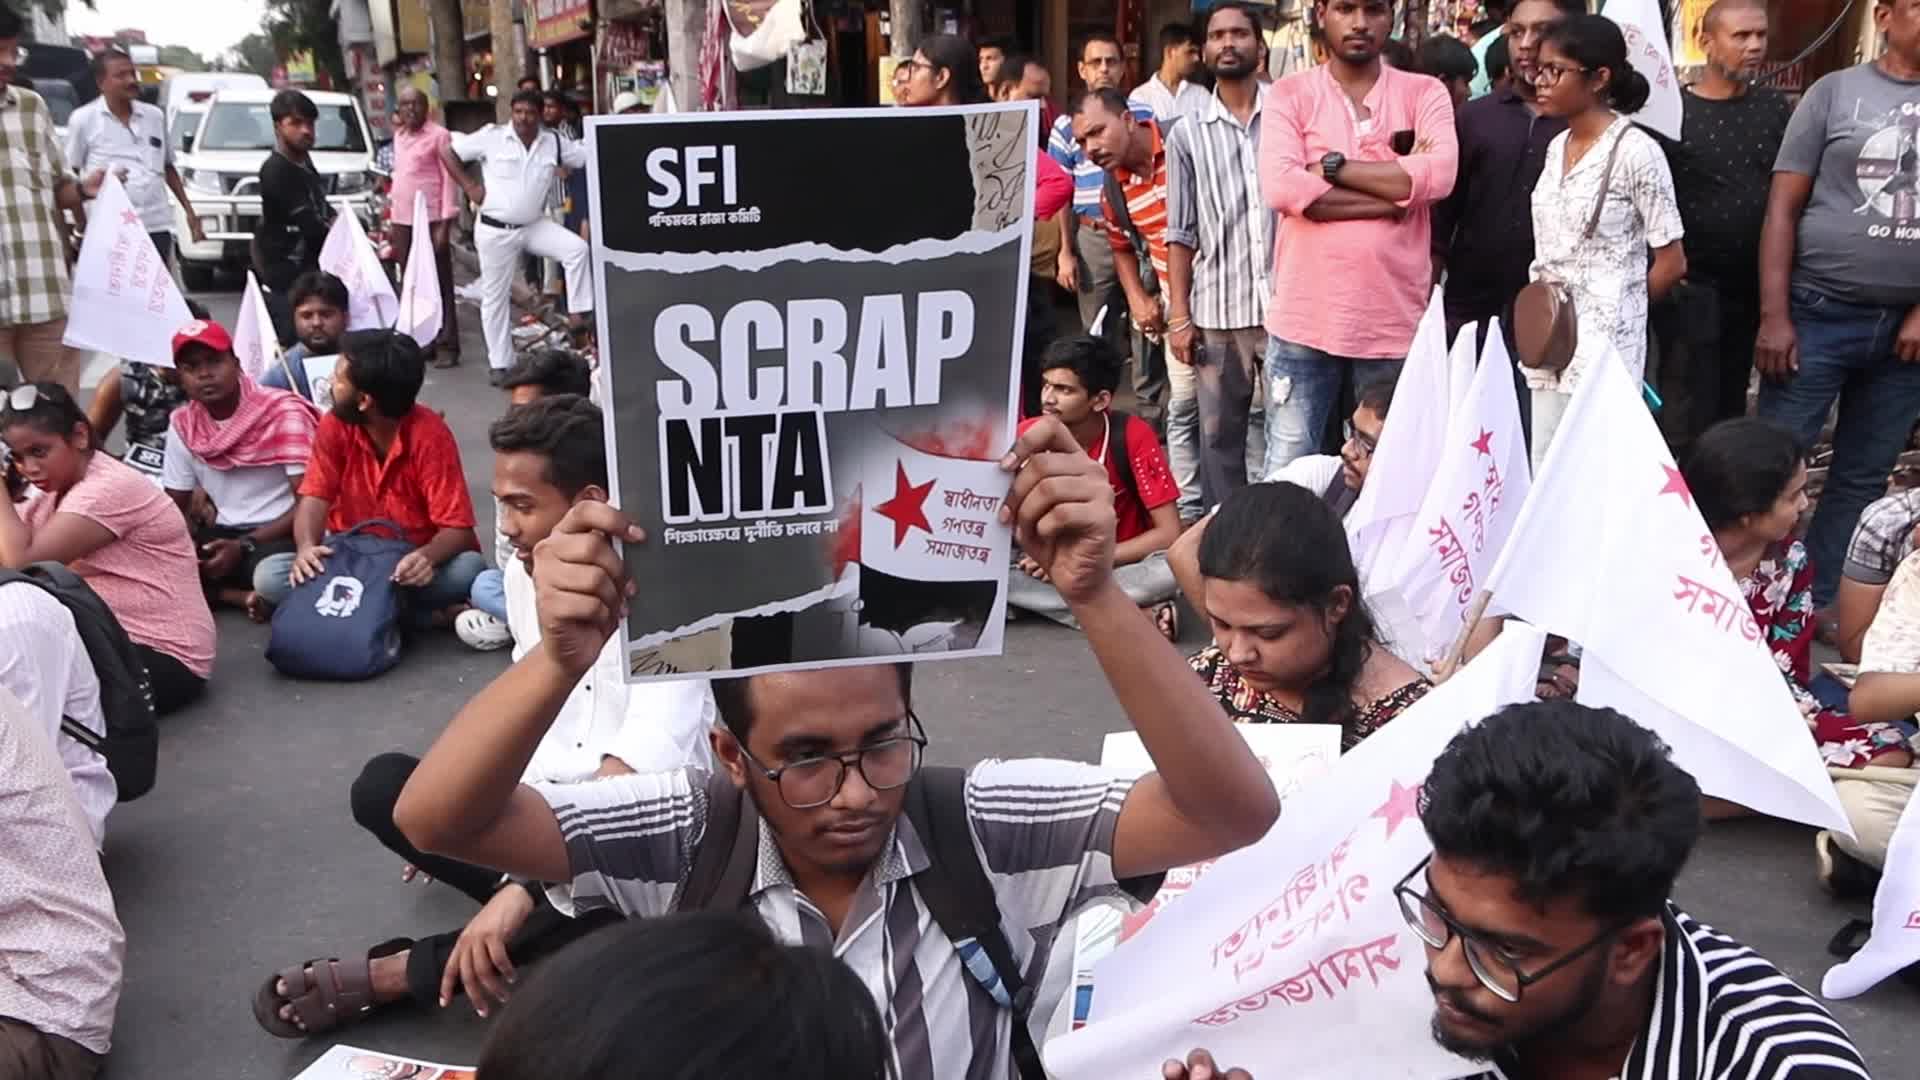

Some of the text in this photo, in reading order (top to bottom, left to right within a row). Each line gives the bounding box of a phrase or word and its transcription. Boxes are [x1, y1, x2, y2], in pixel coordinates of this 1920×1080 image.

[646, 145, 737, 208] SFI
[728, 206, 761, 223] কমিটি
[1867, 224, 1891, 237] GO
[654, 290, 974, 413] SCRAP
[660, 405, 832, 523] NTA
[943, 487, 1000, 512] স্বাধীনতা
[664, 519, 840, 544] শিক্ষাক্ষেত্রে দুর্নীতি চলবে না
[925, 539, 993, 564] সমাজতন্ত্র
